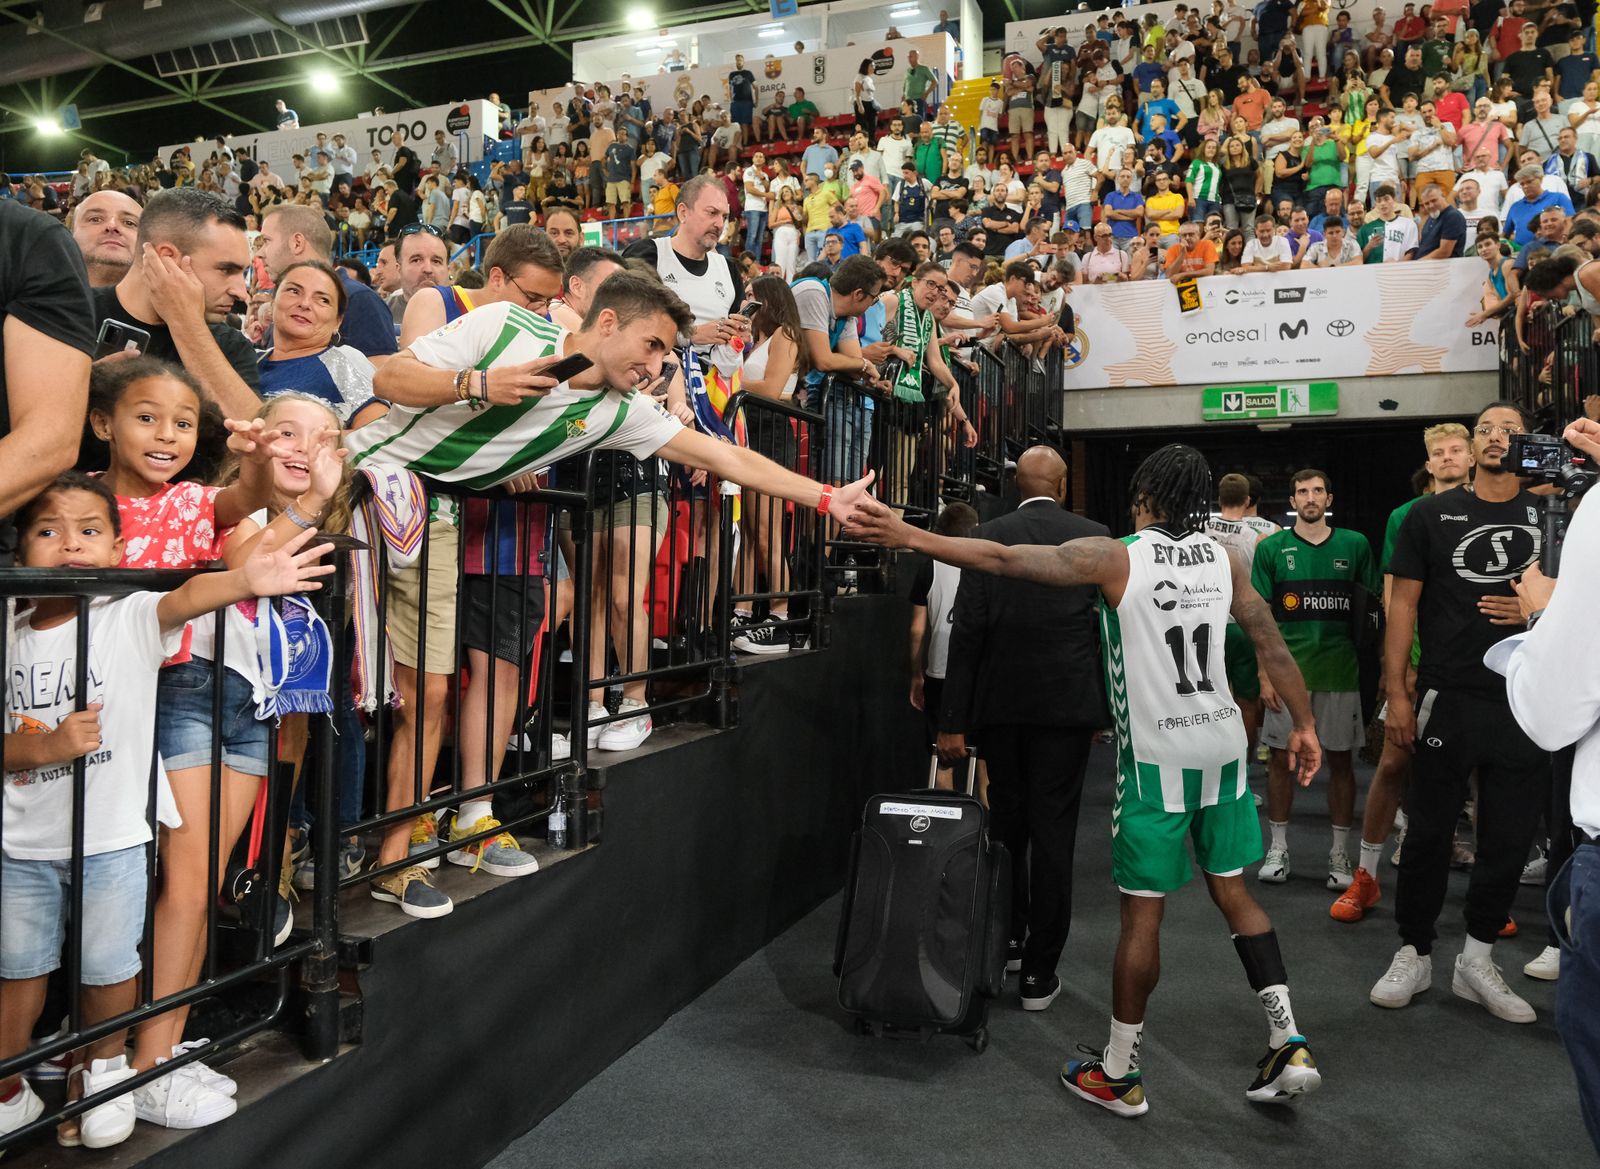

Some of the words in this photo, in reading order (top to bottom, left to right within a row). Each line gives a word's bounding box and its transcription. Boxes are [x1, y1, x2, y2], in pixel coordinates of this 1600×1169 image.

[760, 82, 786, 93] BARÇA
[366, 120, 427, 147] TODO
[1185, 327, 1259, 344] endesa
[1471, 331, 1499, 346] BA
[1246, 397, 1276, 406] SALIDA
[1440, 514, 1468, 522] SPALDING
[1152, 542, 1216, 567] EVANS
[1303, 596, 1350, 611] PROBITA
[1164, 622, 1217, 698] 11
[1157, 713, 1210, 730] FOREVER
[244, 880, 252, 894] 2
